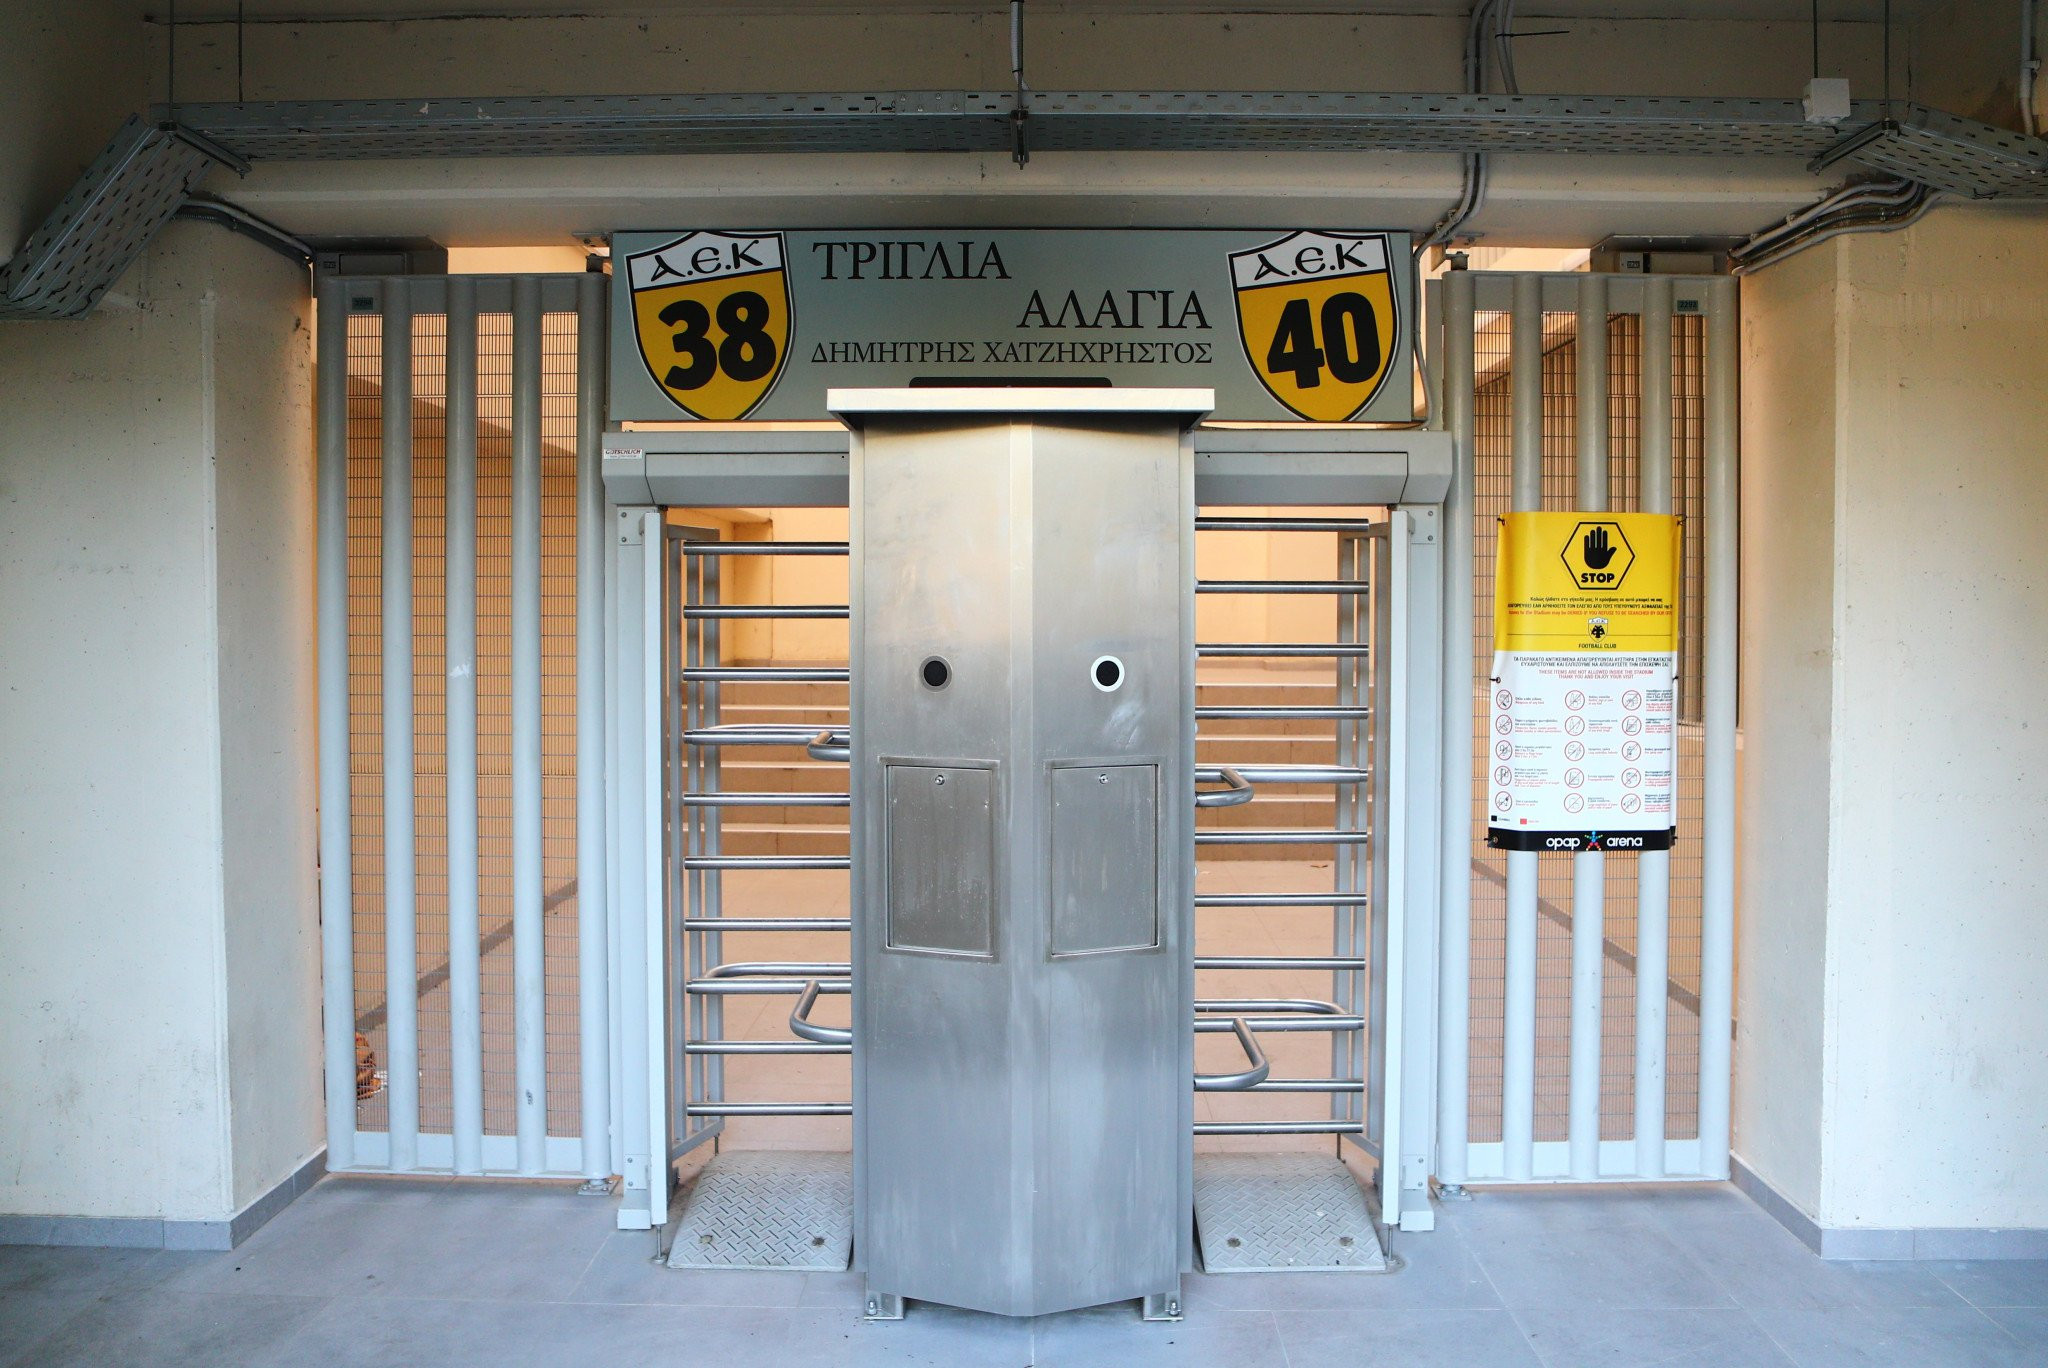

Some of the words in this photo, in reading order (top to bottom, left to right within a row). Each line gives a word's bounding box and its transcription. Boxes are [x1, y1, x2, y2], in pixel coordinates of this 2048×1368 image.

[812, 241, 1012, 280] ΤΡΙΓΛΙΑ
[1016, 289, 1213, 329] ΑΛΑΓΙΑ
[658, 290, 777, 391] 38
[811, 341, 976, 363] ΔΗΜΗΤΡΗΣ
[982, 341, 1213, 364] ΧΑΤΖΗΧΡΗΣΤΟΣ
[1266, 291, 1381, 389] 40
[1581, 572, 1615, 583] STOP
[1546, 837, 1580, 850] opap
[1606, 837, 1643, 847] arena
